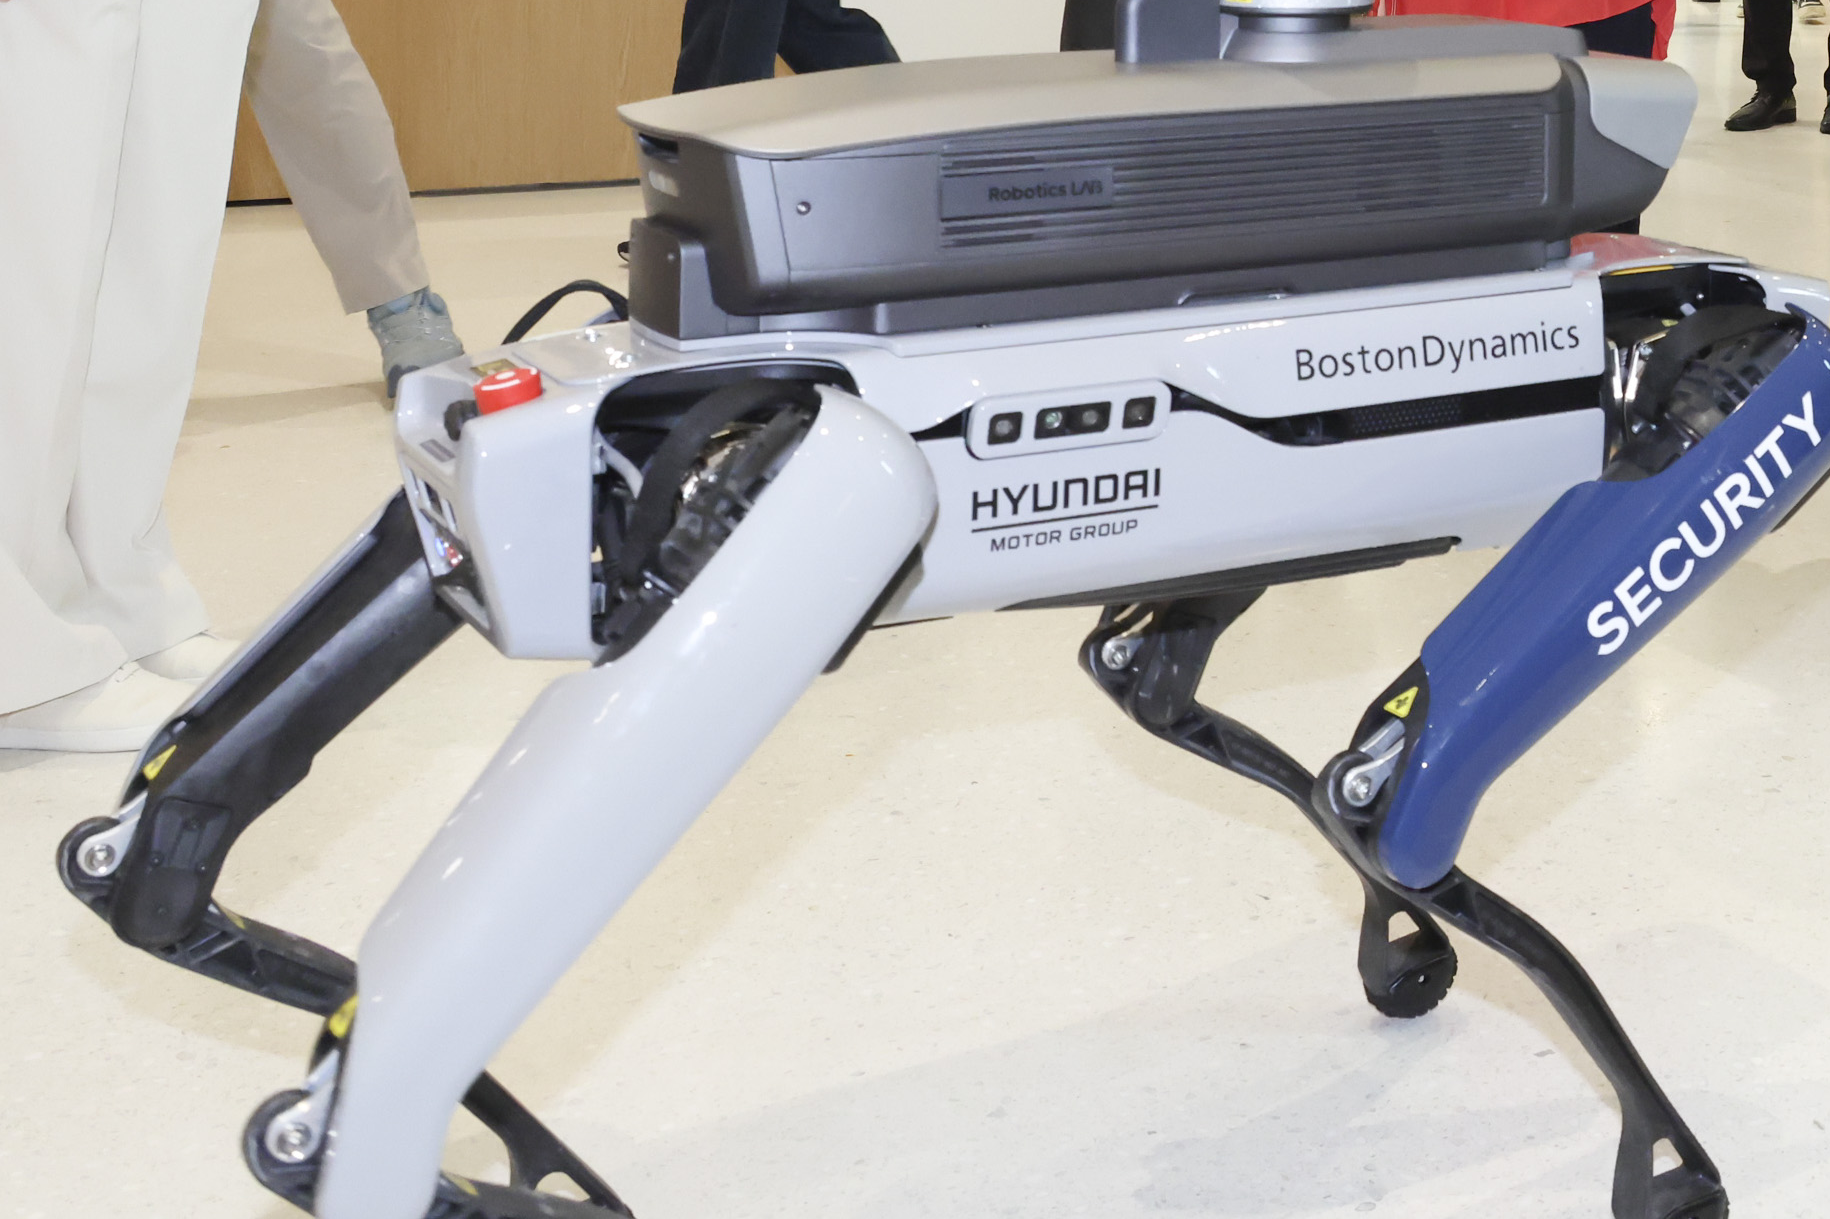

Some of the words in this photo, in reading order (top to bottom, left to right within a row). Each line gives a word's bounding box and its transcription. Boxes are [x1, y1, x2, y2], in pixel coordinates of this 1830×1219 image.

[988, 182, 1067, 201] Robotics
[971, 468, 1161, 521] HYUNDAI
[990, 529, 1062, 552] MOTOR
[1069, 519, 1138, 541] GROUP
[1586, 391, 1822, 656] SECURITY
